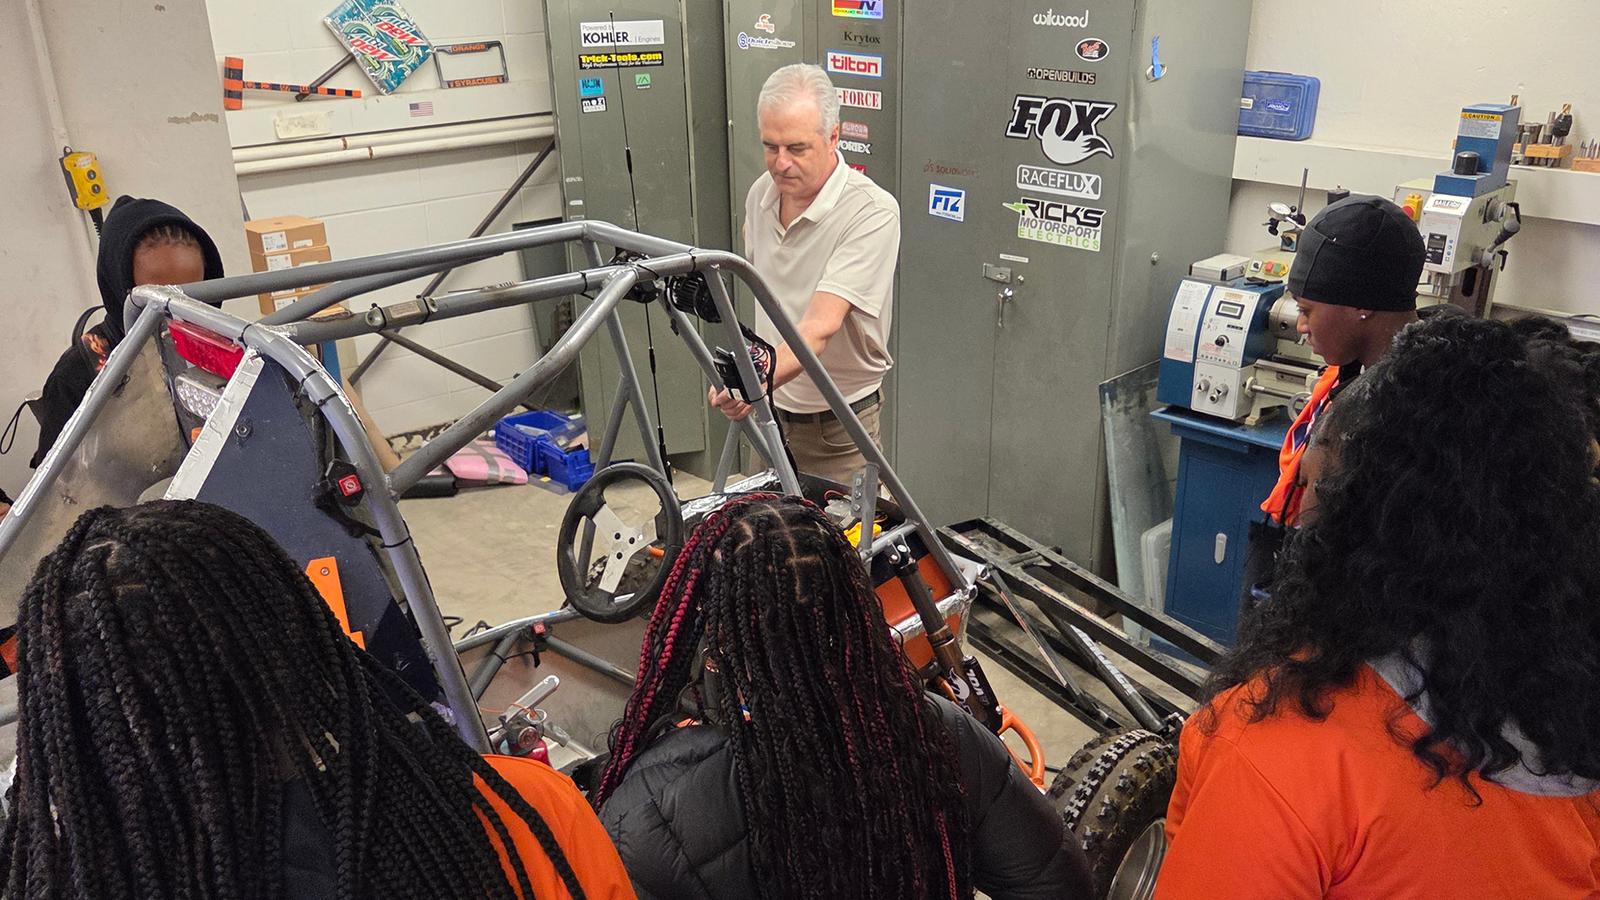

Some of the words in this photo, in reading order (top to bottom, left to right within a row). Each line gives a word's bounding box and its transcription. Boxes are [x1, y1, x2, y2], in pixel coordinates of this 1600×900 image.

[1033, 8, 1089, 28] wilwood
[583, 31, 629, 44] KOHLER
[844, 31, 880, 44] Krytox
[580, 53, 662, 63] Trick-Tools.com
[831, 55, 878, 74] tilton
[454, 77, 498, 87] SYRACUSE
[1036, 69, 1095, 84] OPENBUILDS
[838, 90, 880, 108] -FORCE
[1008, 98, 1112, 142] FOX
[1021, 168, 1096, 195] RACEFLUX
[1021, 199, 1105, 228] RICK'S
[1019, 217, 1100, 240] MOTORSPORT
[1018, 228, 1100, 250] ELECTRICS
